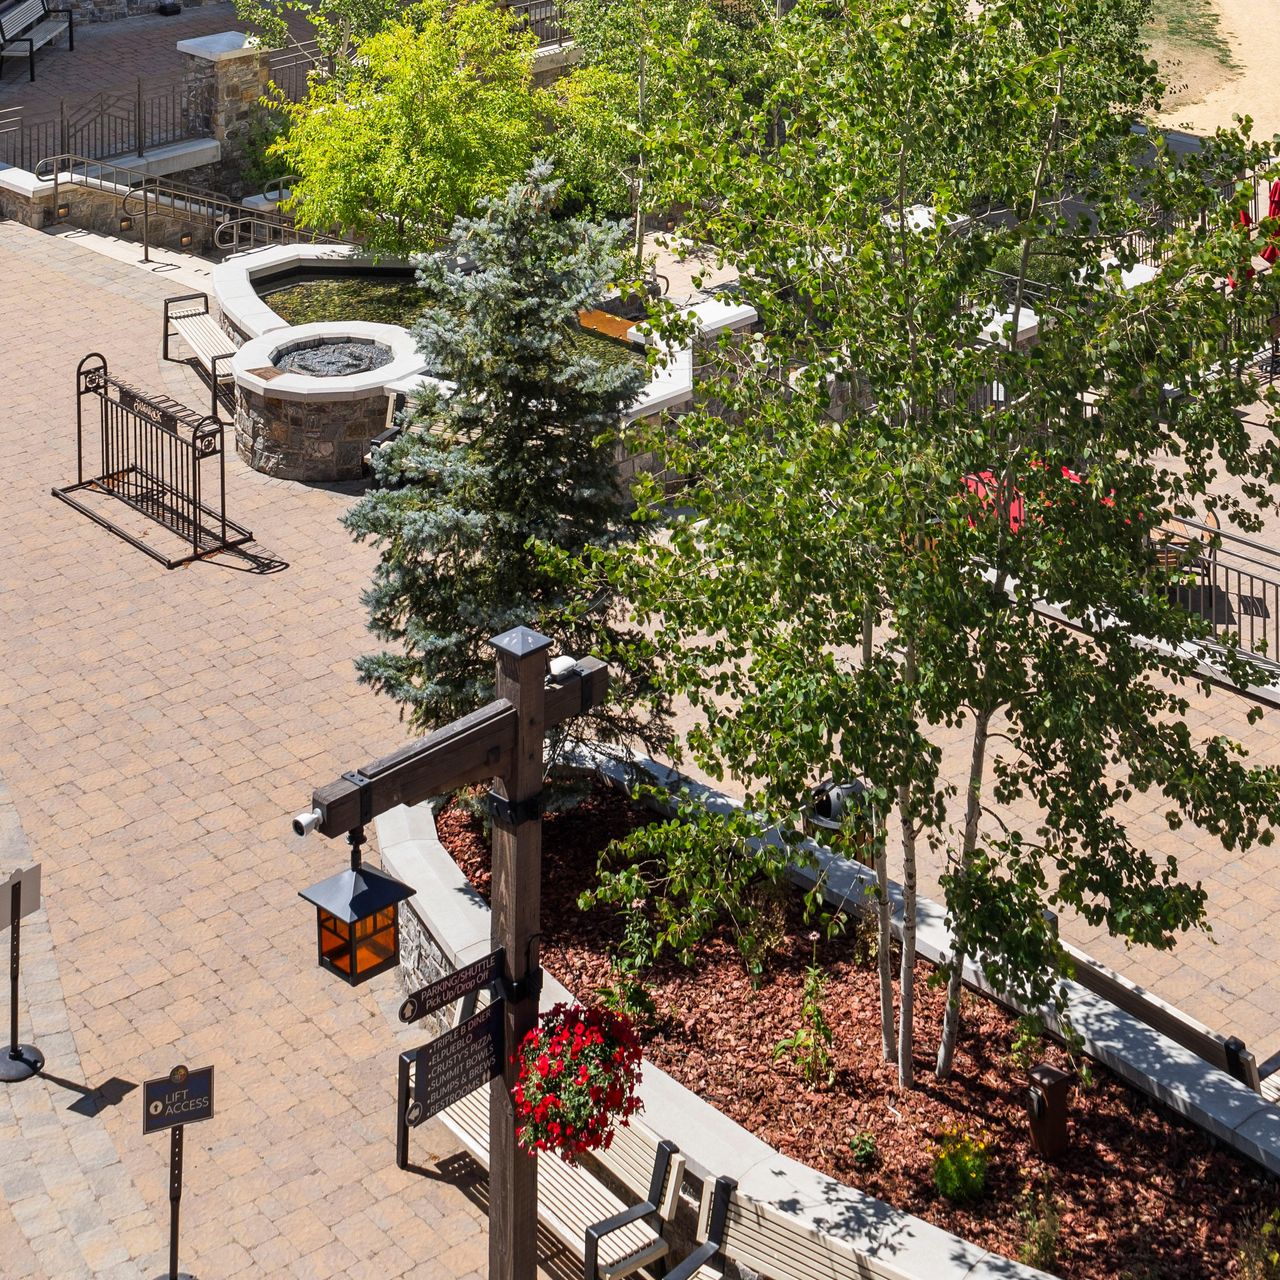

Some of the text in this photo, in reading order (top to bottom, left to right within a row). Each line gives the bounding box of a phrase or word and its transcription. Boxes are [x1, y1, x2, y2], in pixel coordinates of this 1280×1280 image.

[421, 955, 496, 1000] PARKING/SHUTTLE
[426, 970, 490, 1010] Pick Up/Drop Off
[431, 1033, 473, 1065] ELPUEBLO
[433, 1009, 491, 1052] TRIPLE B DINER
[430, 1043, 494, 1090] SUMMIT BOWLS
[431, 1033, 492, 1078] CRUSTY'S PIZZA
[165, 1089, 189, 1104] LIFT
[430, 1055, 496, 1103] BUMPS & BREWS
[430, 1079, 480, 1116] RESTROOMS
[165, 1096, 209, 1116] ACCESS
